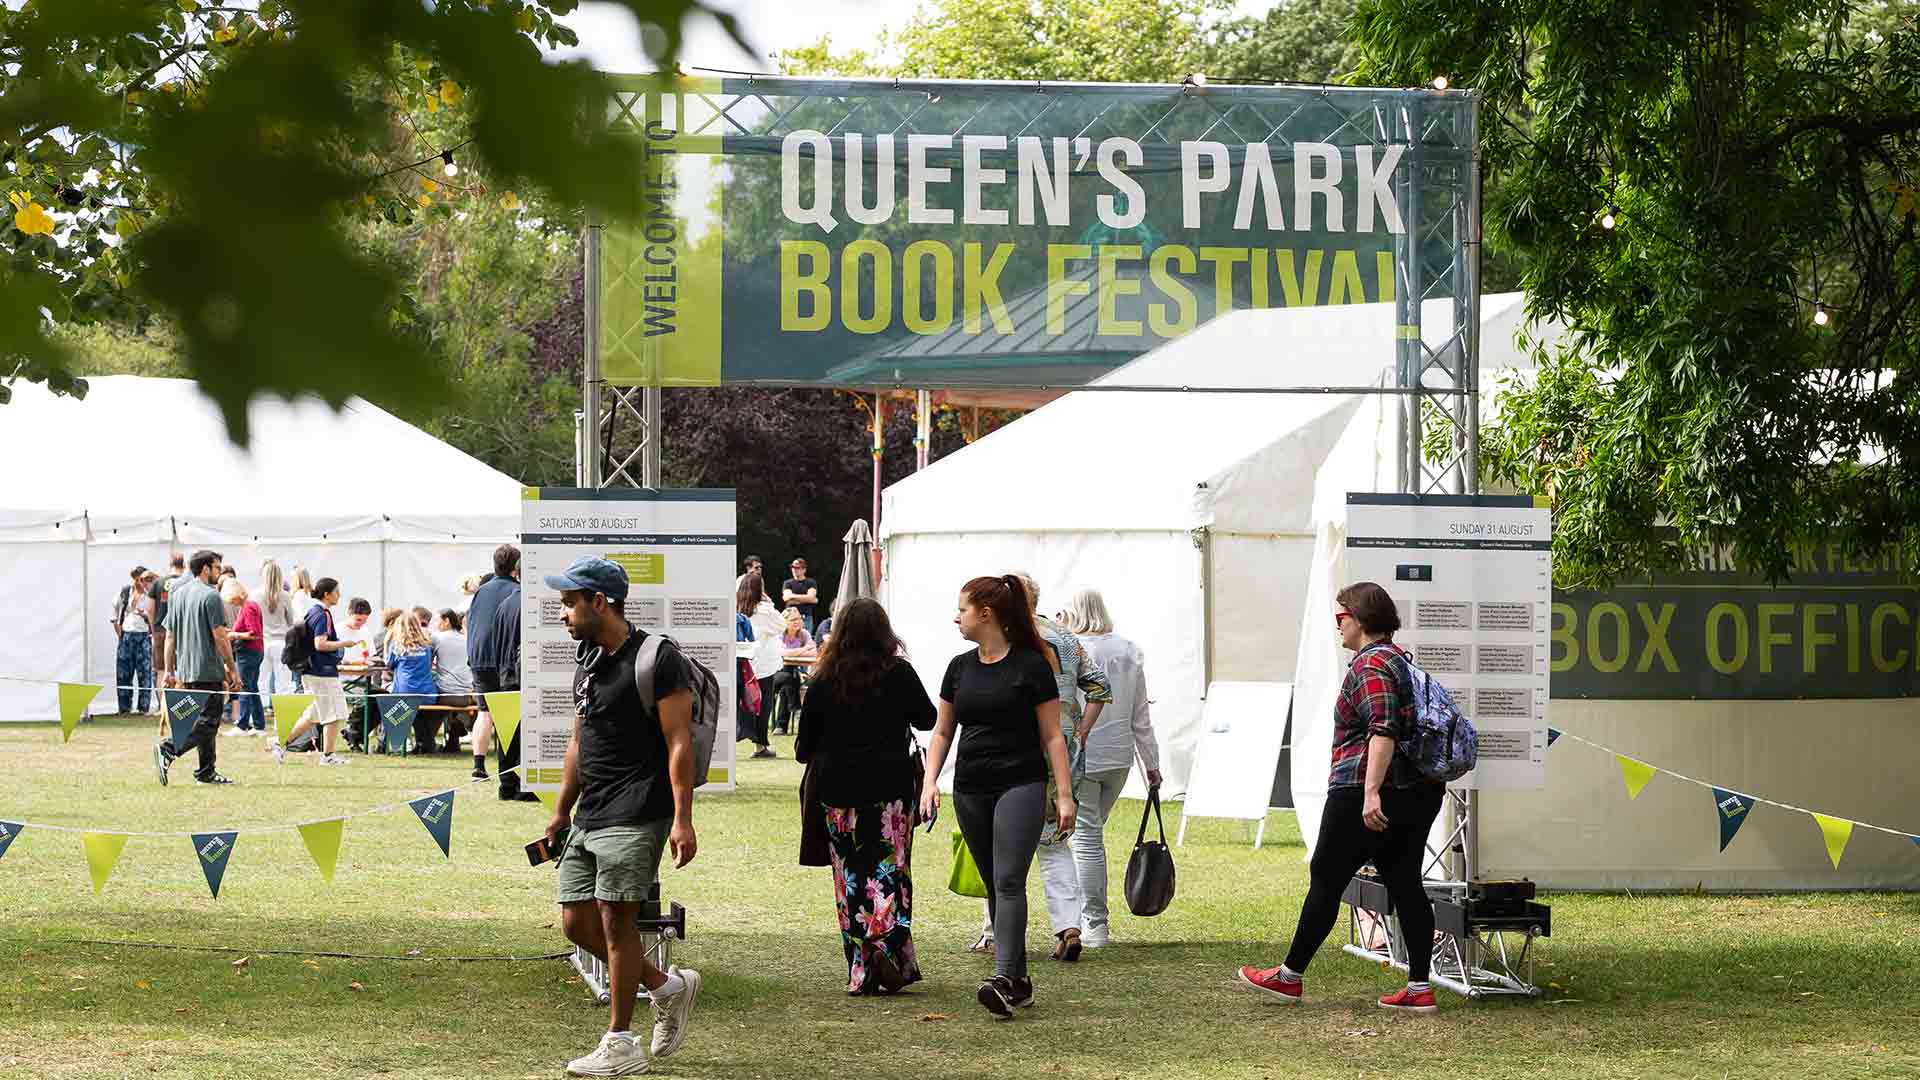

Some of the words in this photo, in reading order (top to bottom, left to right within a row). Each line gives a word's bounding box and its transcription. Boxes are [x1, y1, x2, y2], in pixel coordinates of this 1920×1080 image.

[644, 119, 677, 155] TO
[780, 128, 1146, 234] QUEEN'S
[1180, 140, 1407, 235] PARK
[643, 173, 677, 337] WELCOME
[779, 239, 1017, 335] BOOK
[539, 517, 586, 529] SATURDAY
[588, 517, 599, 529] 30
[601, 517, 638, 529] AUGUST
[1449, 523, 1486, 535] SUNDAY
[1487, 523, 1497, 535] 31
[1499, 524, 1534, 536] AUGUST
[1550, 601, 1681, 673] BOX
[1705, 602, 1920, 674] OFFIC
